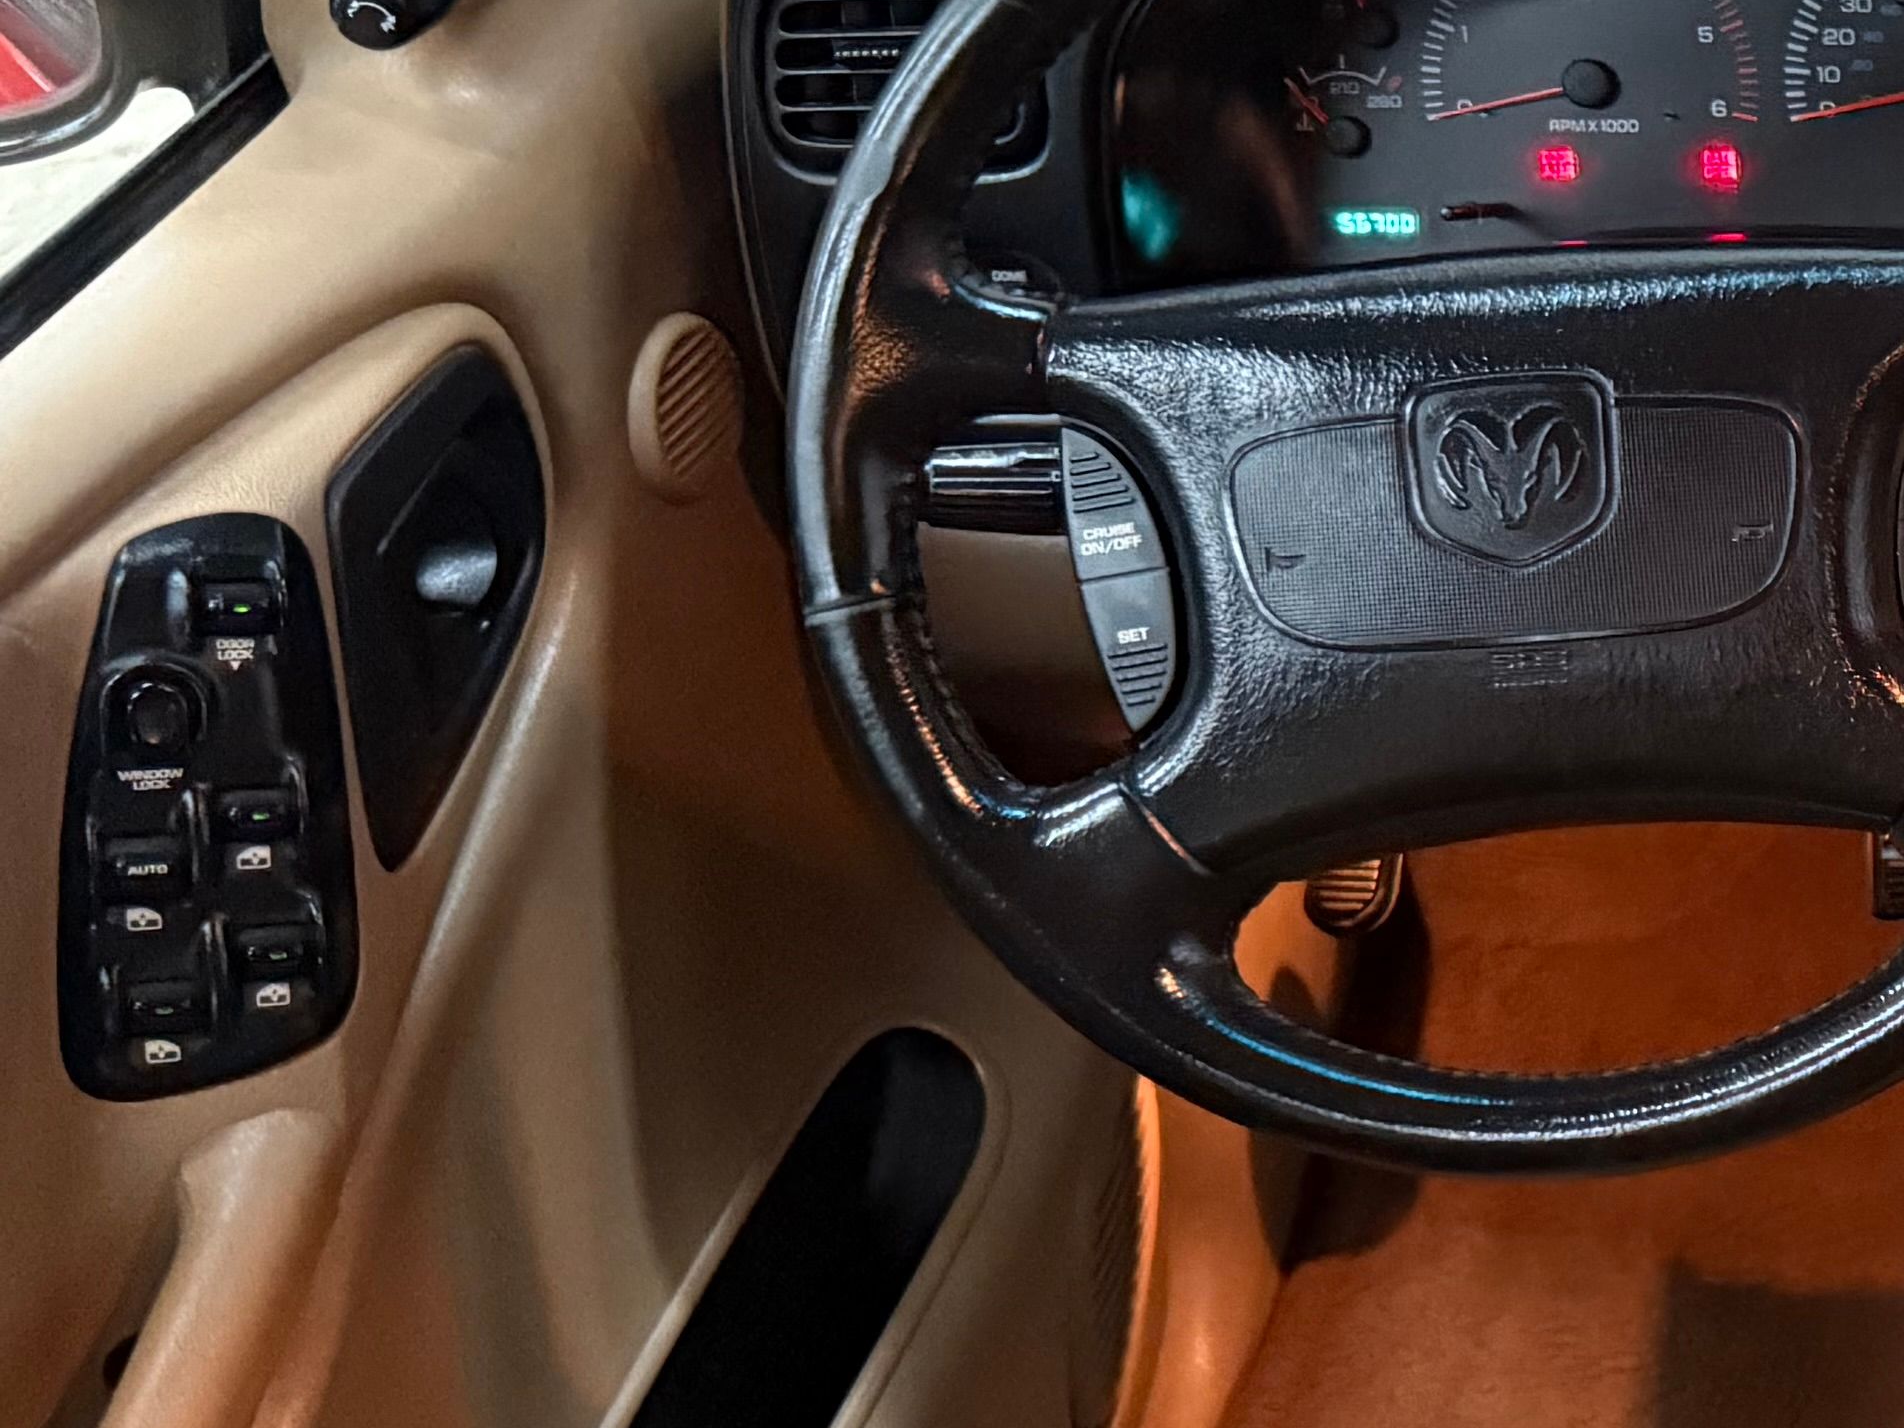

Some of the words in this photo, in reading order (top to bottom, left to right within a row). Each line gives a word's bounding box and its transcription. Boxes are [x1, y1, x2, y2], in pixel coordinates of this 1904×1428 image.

[1460, 25, 1469, 44] 1
[1697, 25, 1714, 45] 5
[1821, 26, 1857, 47] 20
[1816, 65, 1842, 84] 10
[1329, 81, 1361, 95] 210
[1709, 98, 1729, 119] 6
[1079, 535, 1143, 557] ON/OFF
[214, 638, 255, 651] DOOR
[1115, 626, 1150, 645] SET
[215, 649, 254, 662] LOCK
[116, 767, 185, 782] WINDOW
[130, 778, 173, 791] LOCK
[127, 862, 169, 876] AUTO
